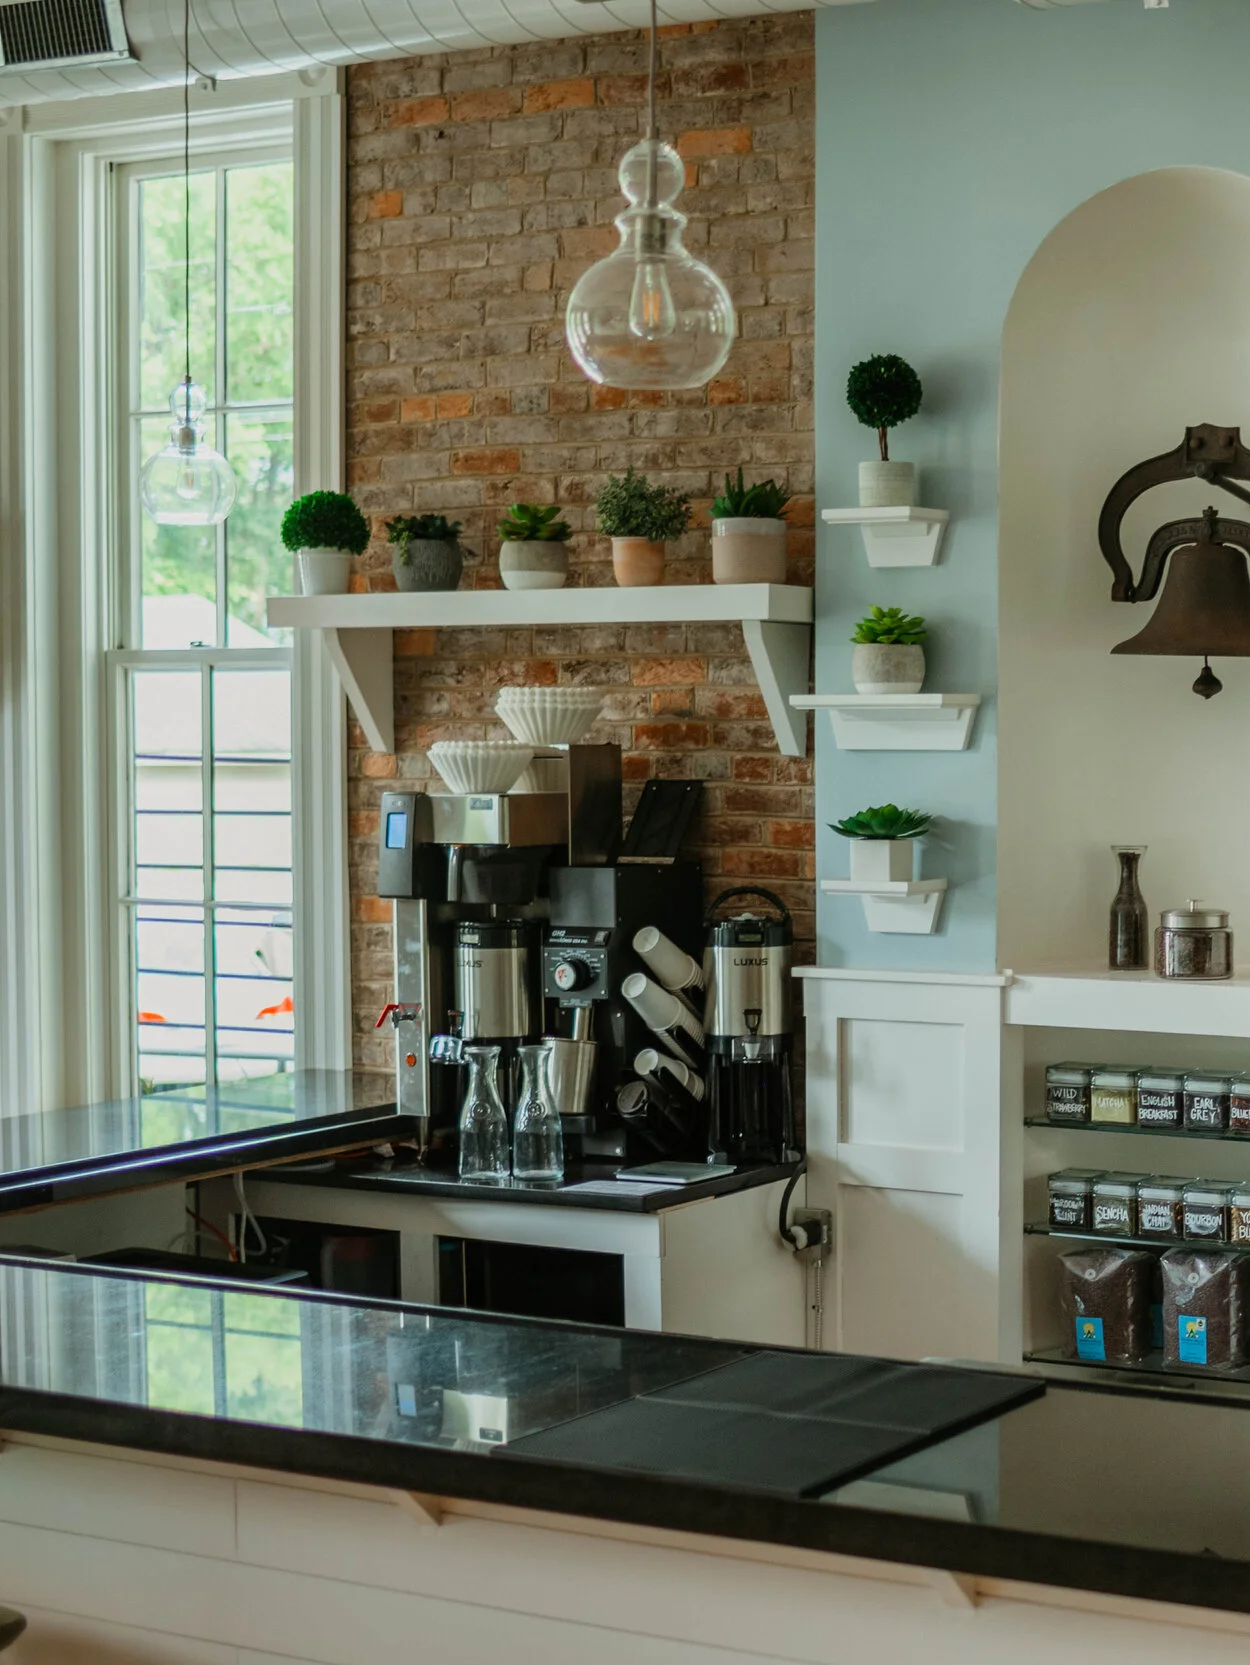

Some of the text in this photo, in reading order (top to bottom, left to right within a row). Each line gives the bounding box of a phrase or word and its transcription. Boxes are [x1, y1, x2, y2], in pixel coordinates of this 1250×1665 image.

[734, 958, 768, 966] LUXUS
[1053, 1088, 1078, 1099] WILD
[1141, 1094, 1175, 1108] ENGLISH
[1194, 1097, 1216, 1110] EARL
[1139, 1108, 1178, 1120] BREAKFAST
[1190, 1110, 1216, 1124] GREY
[1096, 1206, 1129, 1221] SENCHA
[1184, 1212, 1222, 1226] BOURBON
